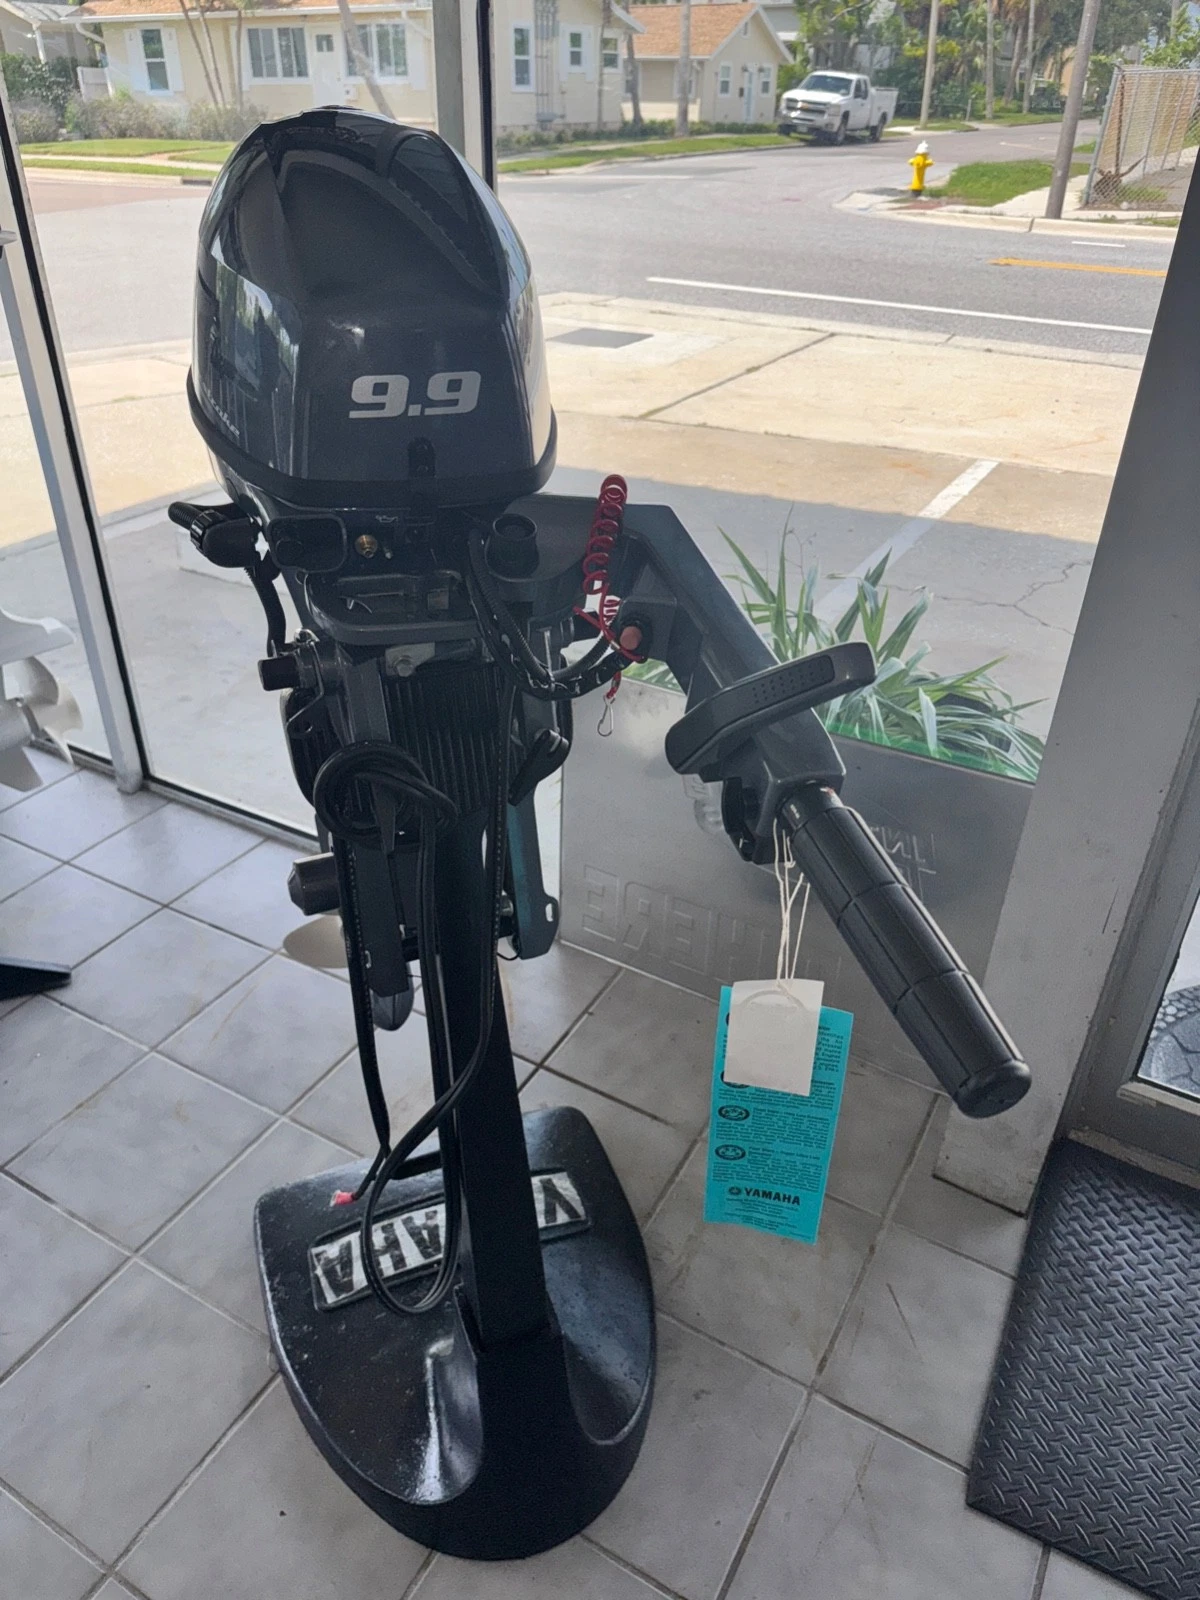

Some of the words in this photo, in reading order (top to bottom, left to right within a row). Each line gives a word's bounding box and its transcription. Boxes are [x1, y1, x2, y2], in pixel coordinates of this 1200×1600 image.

[349, 371, 481, 419] 9.9
[744, 1187, 801, 1206] YAMAHA
[314, 1177, 583, 1298] YAHA
